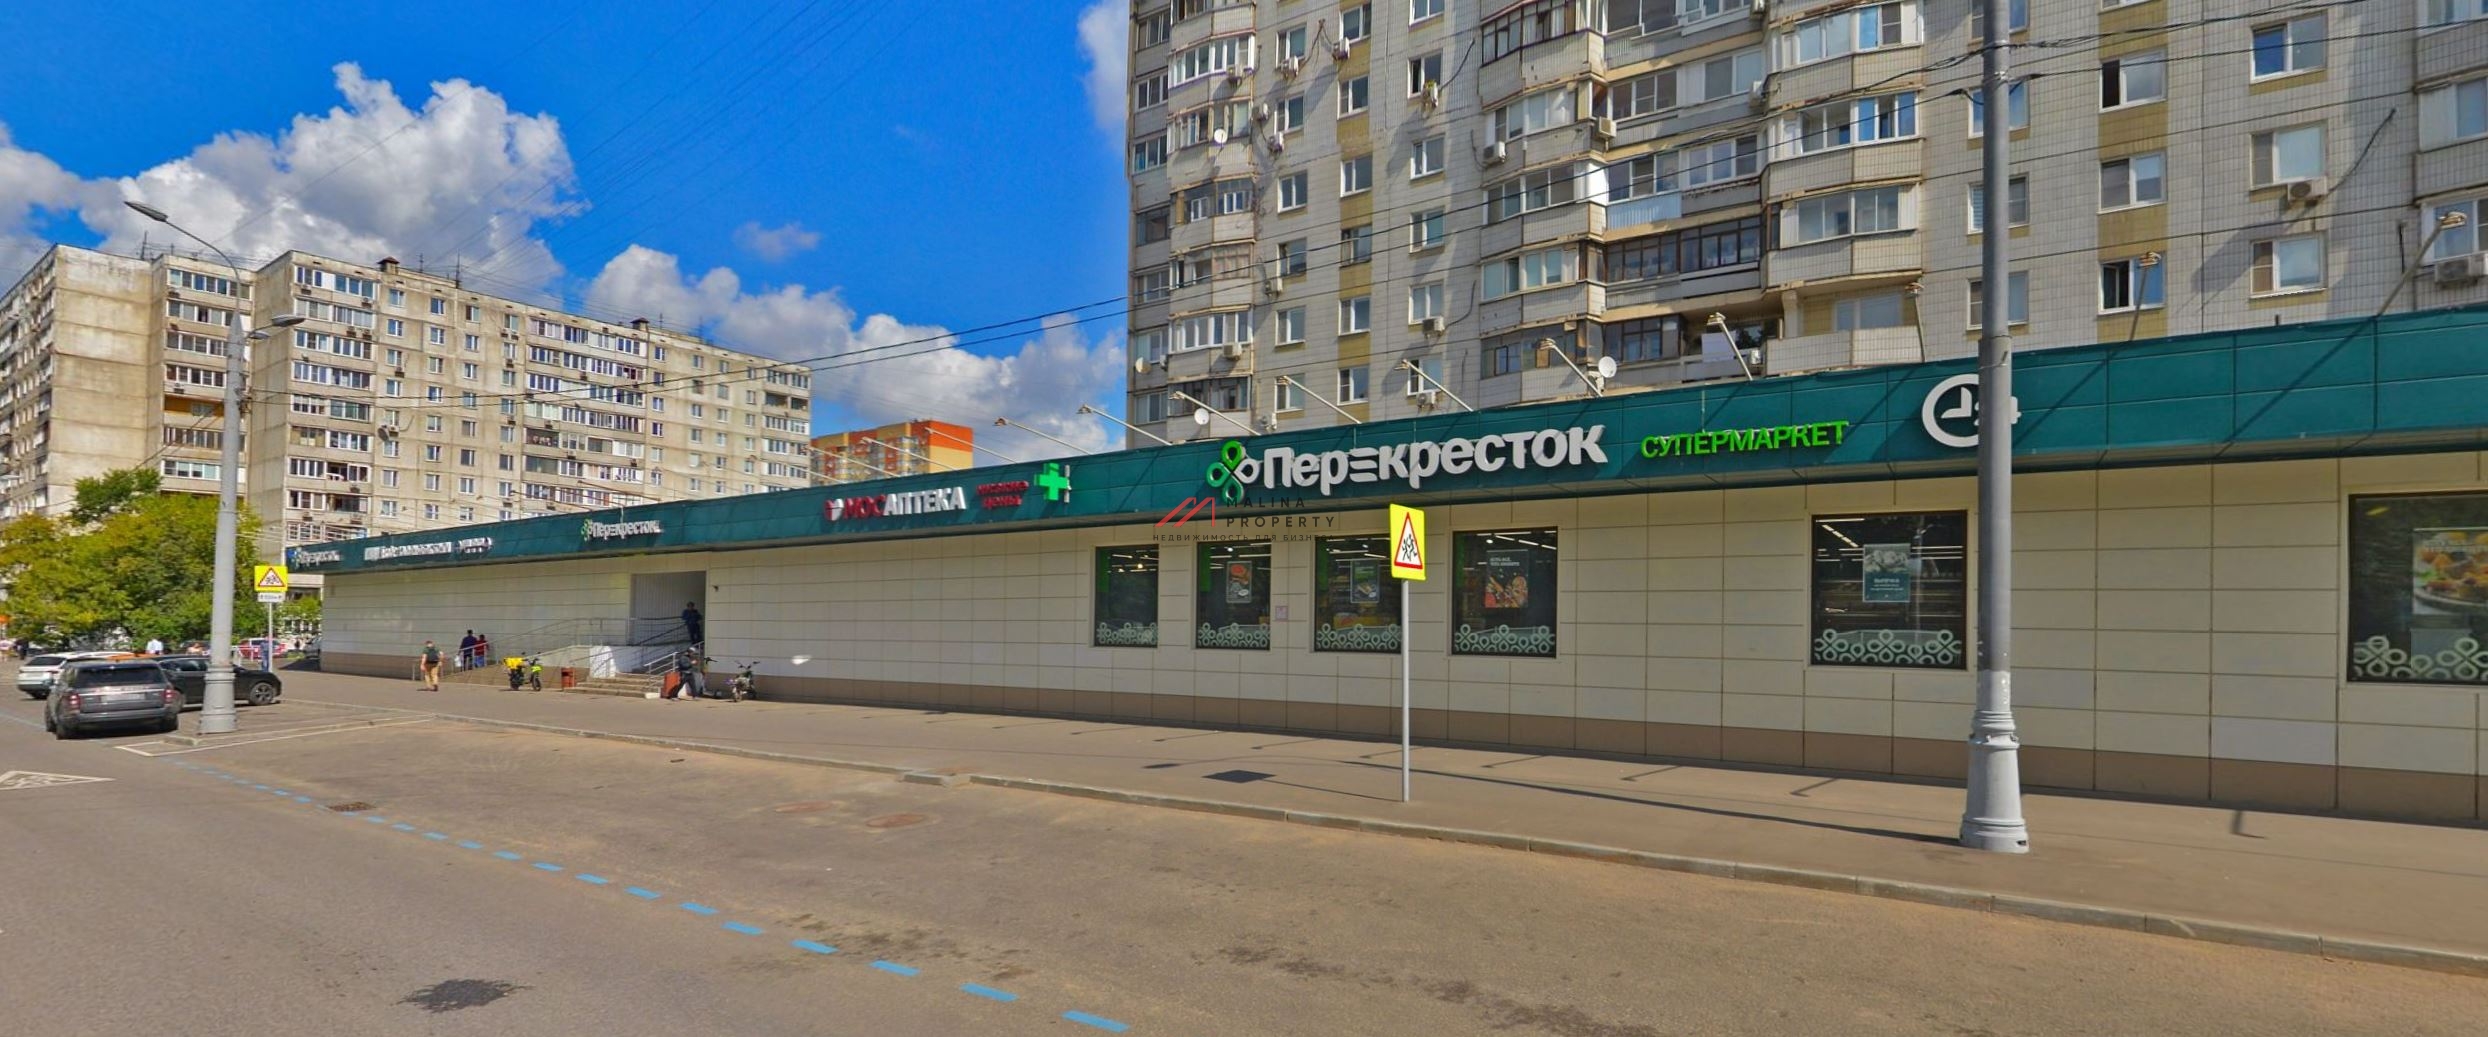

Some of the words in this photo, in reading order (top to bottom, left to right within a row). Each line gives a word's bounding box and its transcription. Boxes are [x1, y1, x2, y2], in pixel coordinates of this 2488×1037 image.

[1641, 421, 1849, 458] СУПЕРМАРКЕТ
[1264, 425, 1607, 496] Перекресток
[844, 486, 966, 519] МОСАПТЕКА
